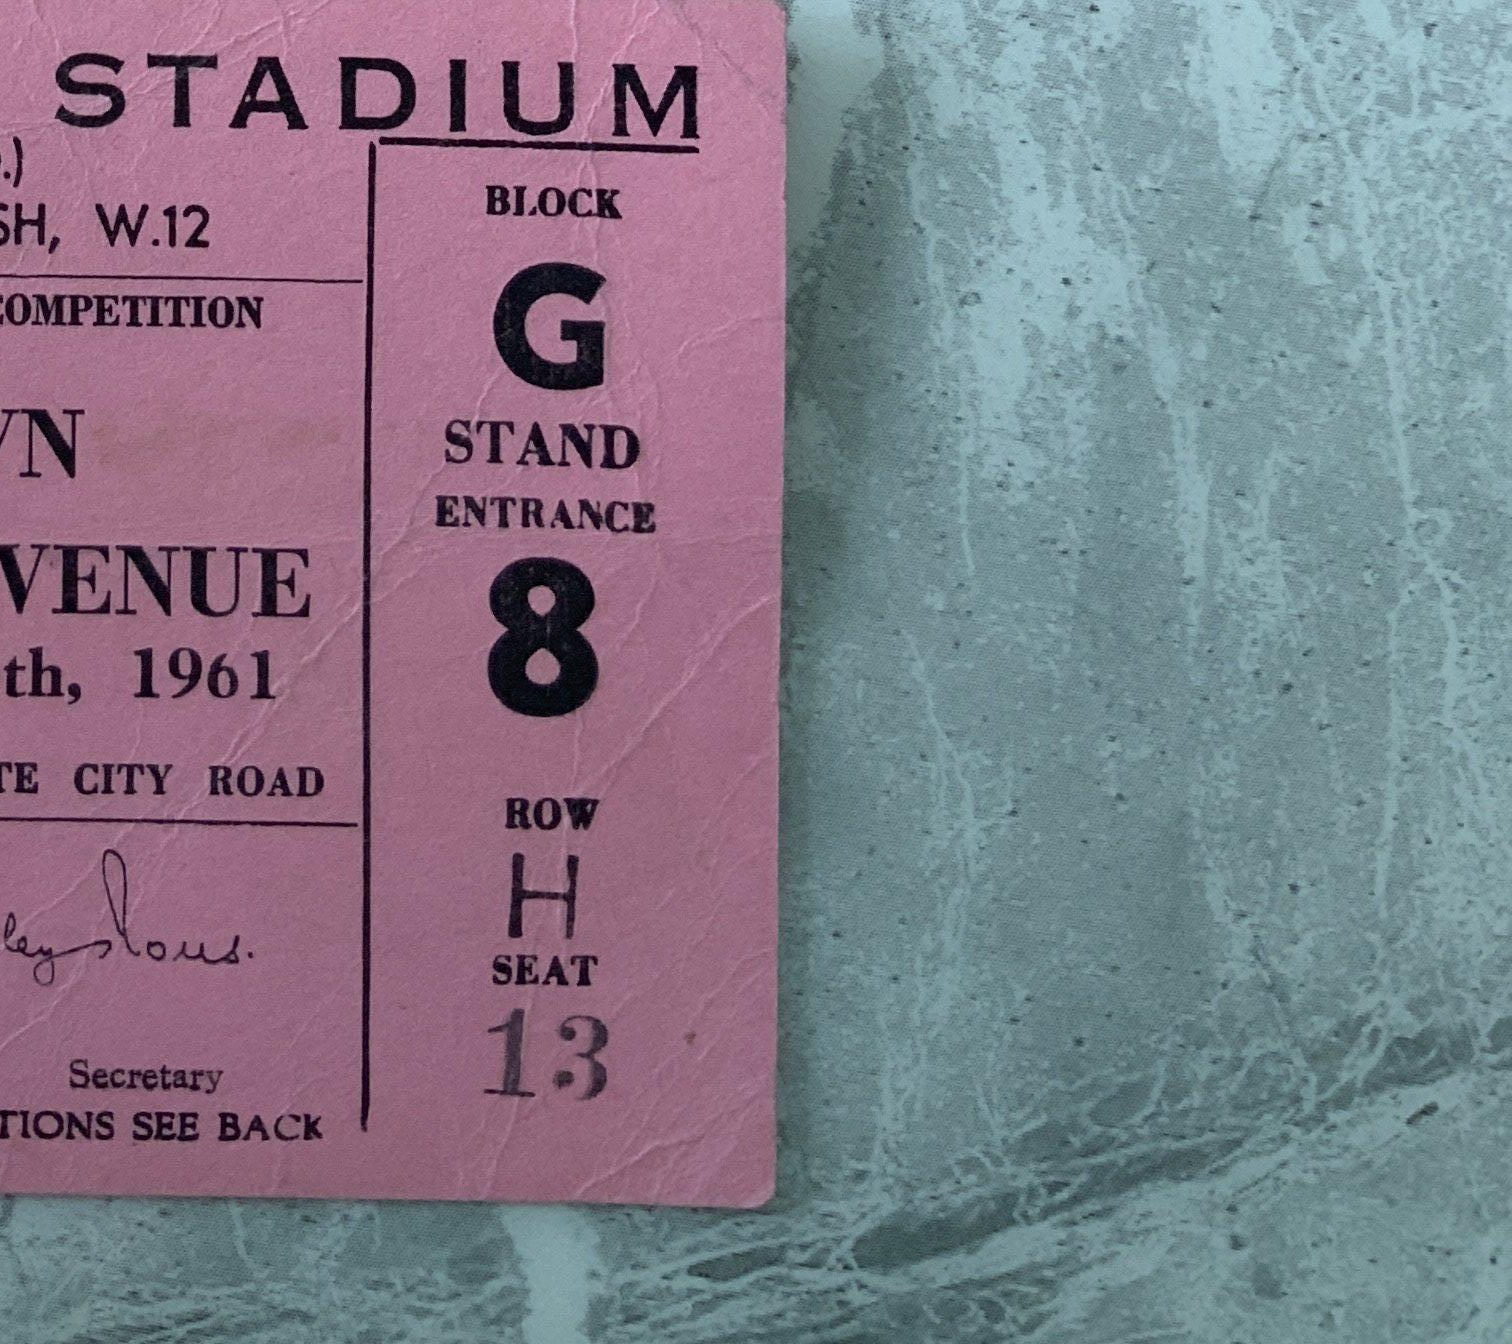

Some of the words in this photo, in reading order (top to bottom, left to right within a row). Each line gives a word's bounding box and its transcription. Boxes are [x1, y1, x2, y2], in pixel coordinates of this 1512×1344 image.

[54, 52, 700, 140] STADIUM
[485, 185, 623, 220] BLOCK
[95, 203, 210, 249] W.12
[492, 262, 607, 391] G
[444, 419, 641, 470] STAND
[435, 495, 657, 534] ENTRANCE
[487, 557, 599, 718] 8
[133, 647, 276, 700] 1961
[73, 763, 173, 796] CITY
[208, 765, 325, 798] ROAD
[505, 797, 600, 831] ROW
[507, 852, 580, 940] H
[492, 954, 599, 987] SEAT
[69, 1058, 224, 1095] Secretary
[483, 1008, 609, 1100] 13
[132, 1111, 200, 1142] SEE
[217, 1111, 323, 1142] BACK
